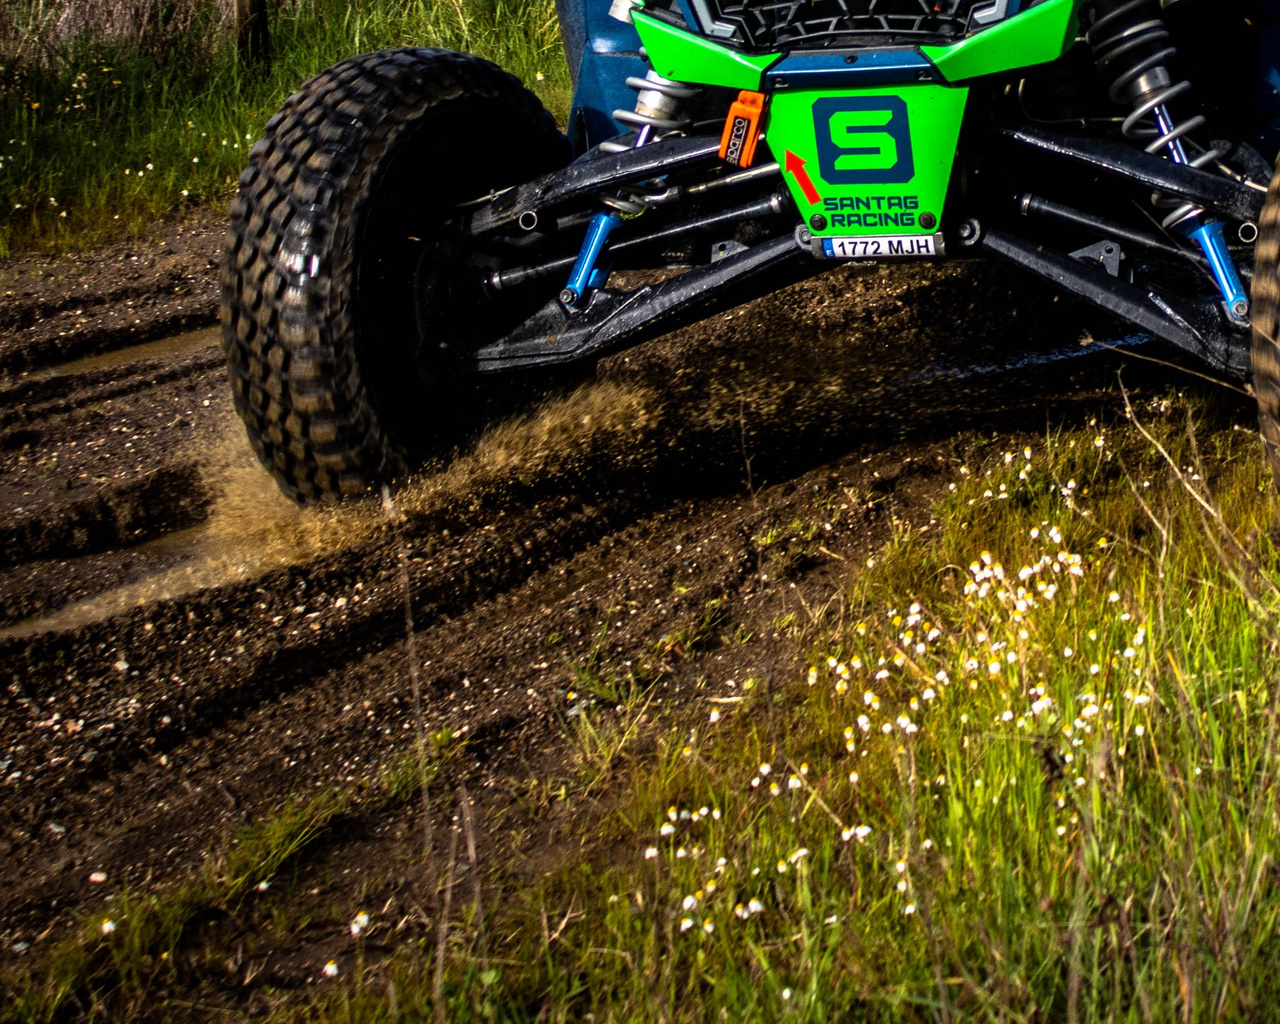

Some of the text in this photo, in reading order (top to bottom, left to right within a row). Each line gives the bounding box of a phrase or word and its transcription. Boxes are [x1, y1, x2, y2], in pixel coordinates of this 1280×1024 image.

[823, 195, 919, 212] SANTAG
[831, 212, 915, 227] RACING
[838, 241, 882, 256] 1772
[888, 239, 931, 255] MJH
